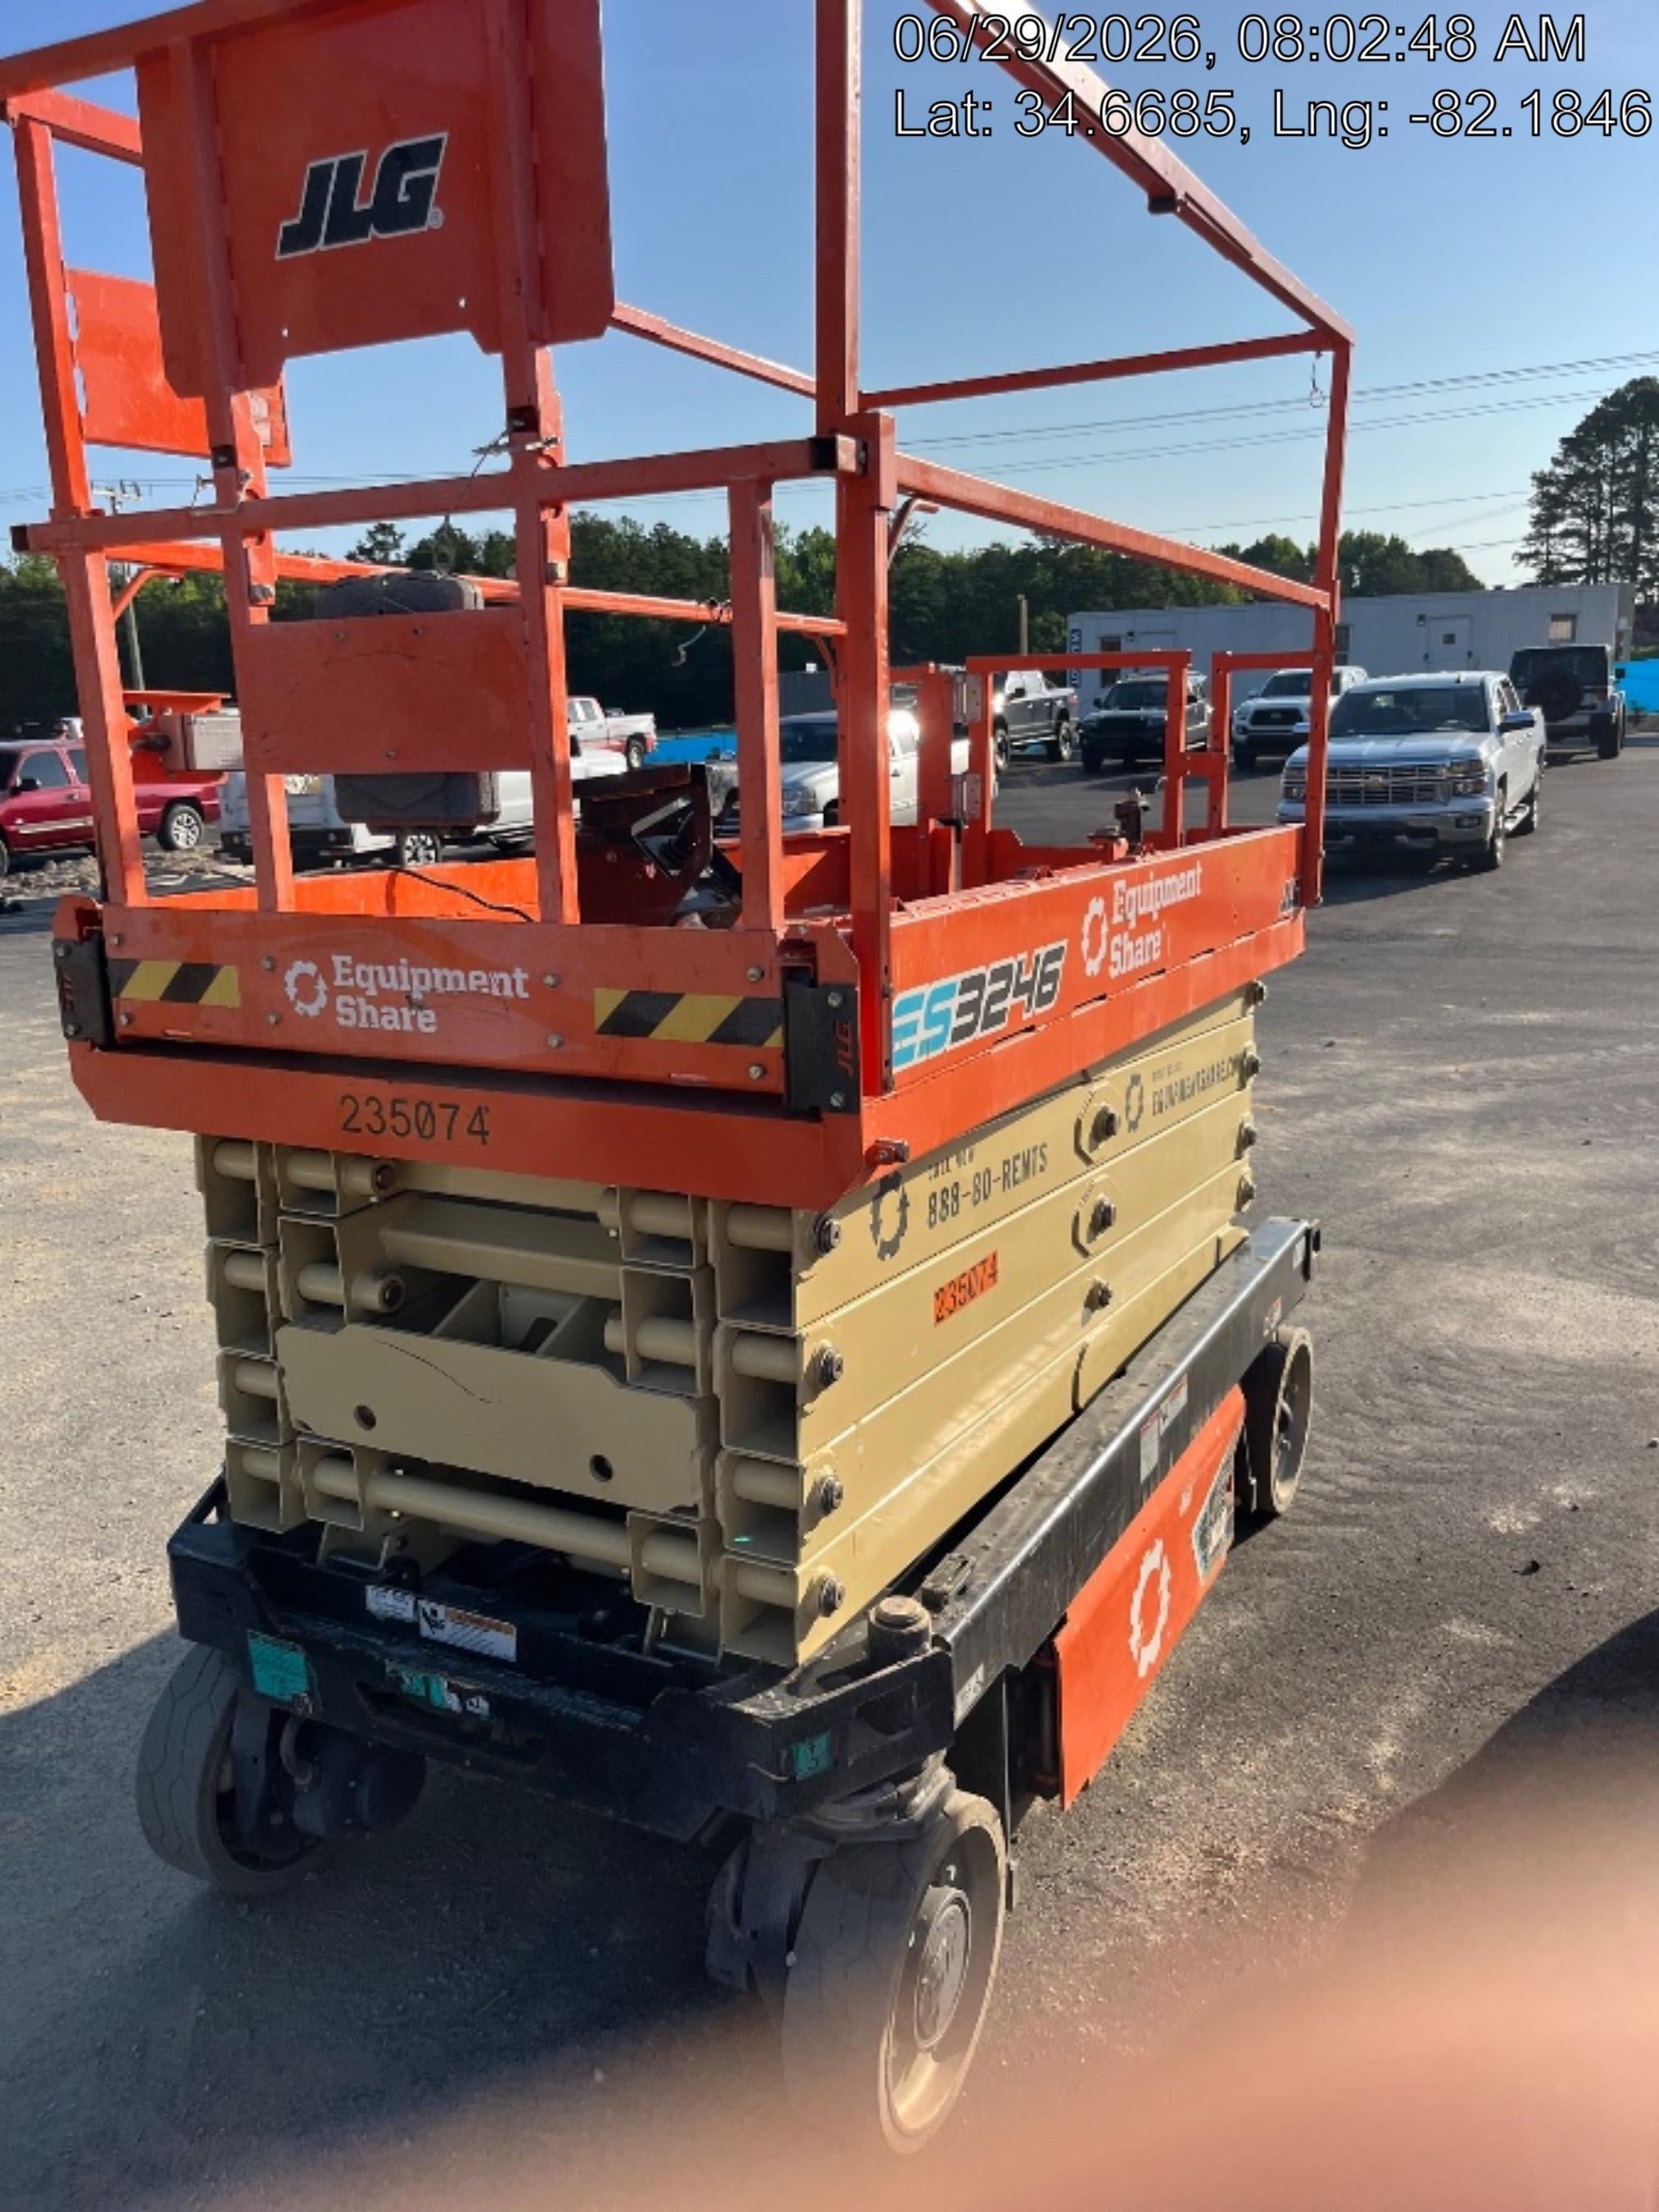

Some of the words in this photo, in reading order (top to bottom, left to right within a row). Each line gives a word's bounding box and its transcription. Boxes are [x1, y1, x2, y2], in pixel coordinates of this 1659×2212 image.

[275, 132, 448, 260] JLG
[1112, 859, 1203, 930] Equipment
[331, 954, 530, 999] Equipment
[1109, 929, 1162, 978] Share
[335, 995, 437, 1034] Share
[892, 939, 1068, 1074] ES3246
[340, 1093, 491, 1146] 235074
[928, 1142, 1049, 1230] 888-80-RENTS
